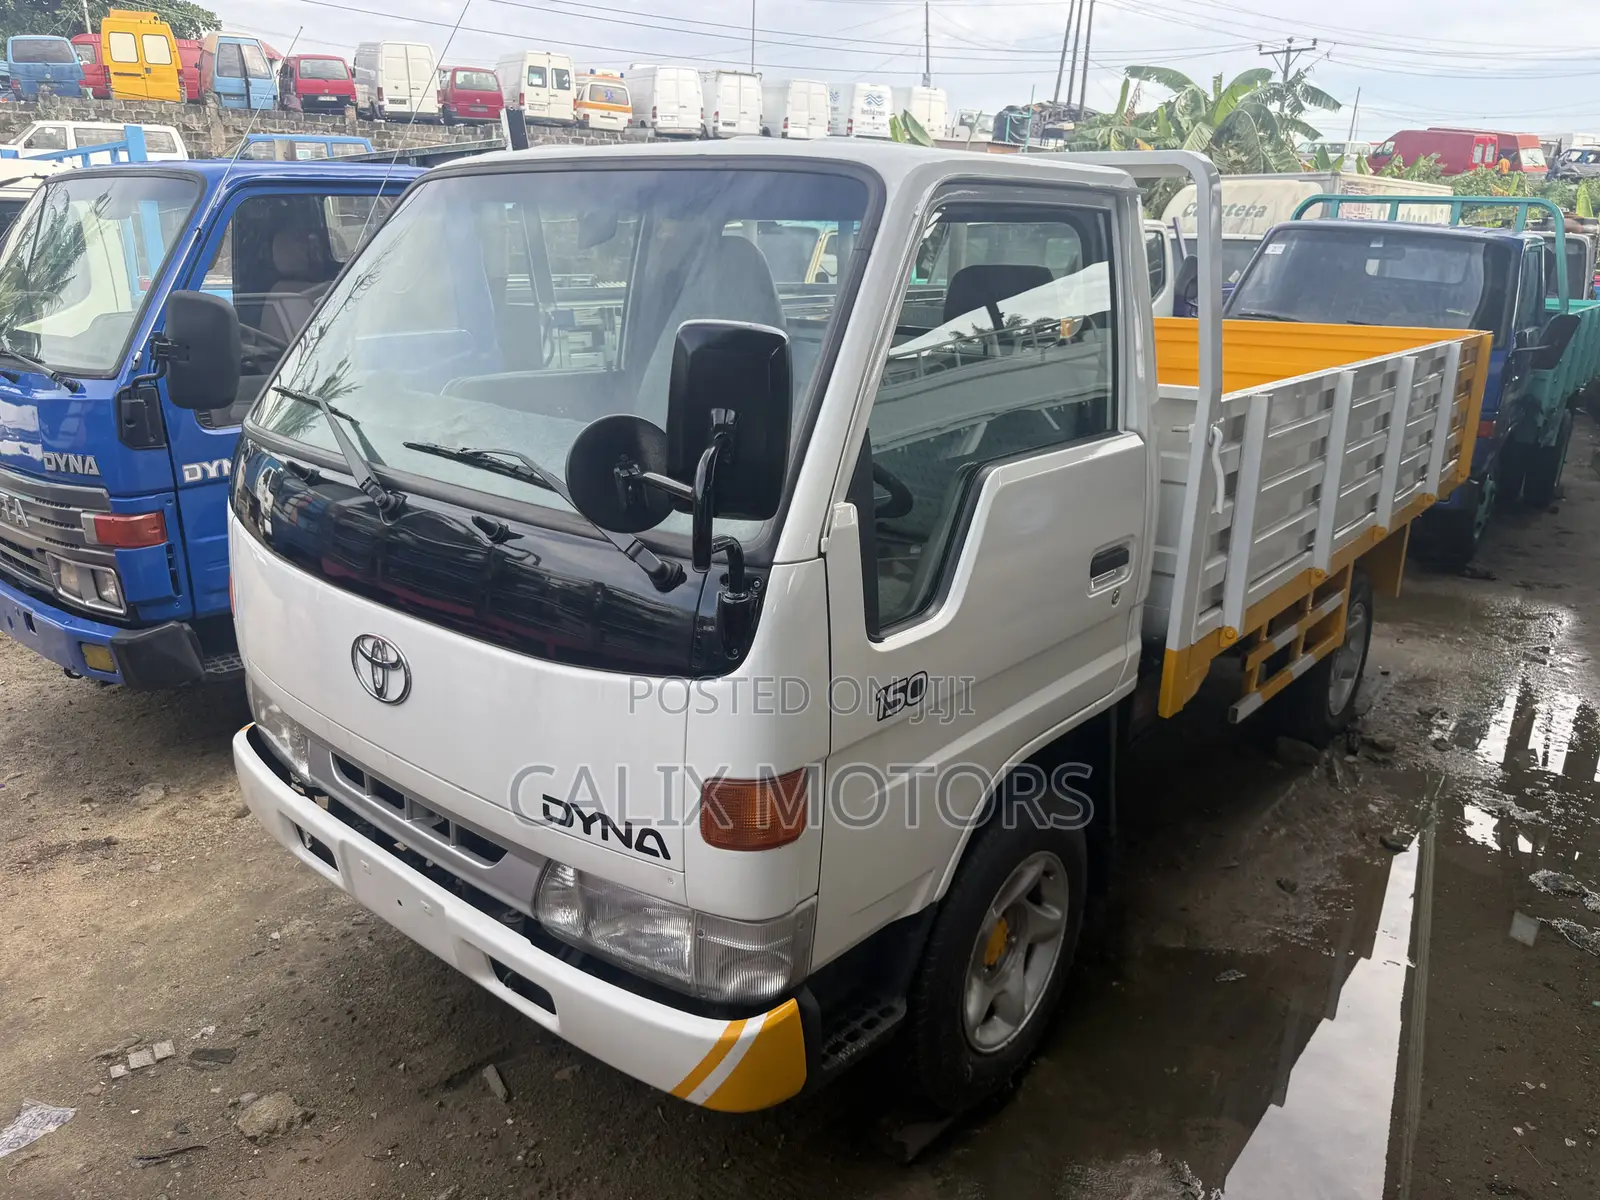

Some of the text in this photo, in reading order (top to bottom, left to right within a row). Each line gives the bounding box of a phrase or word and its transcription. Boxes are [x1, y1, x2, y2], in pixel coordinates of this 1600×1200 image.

[1181, 202, 1268, 218] Cteca
[43, 452, 100, 476] DYNA
[876, 671, 928, 722] 150
[542, 793, 671, 861] DYNA
